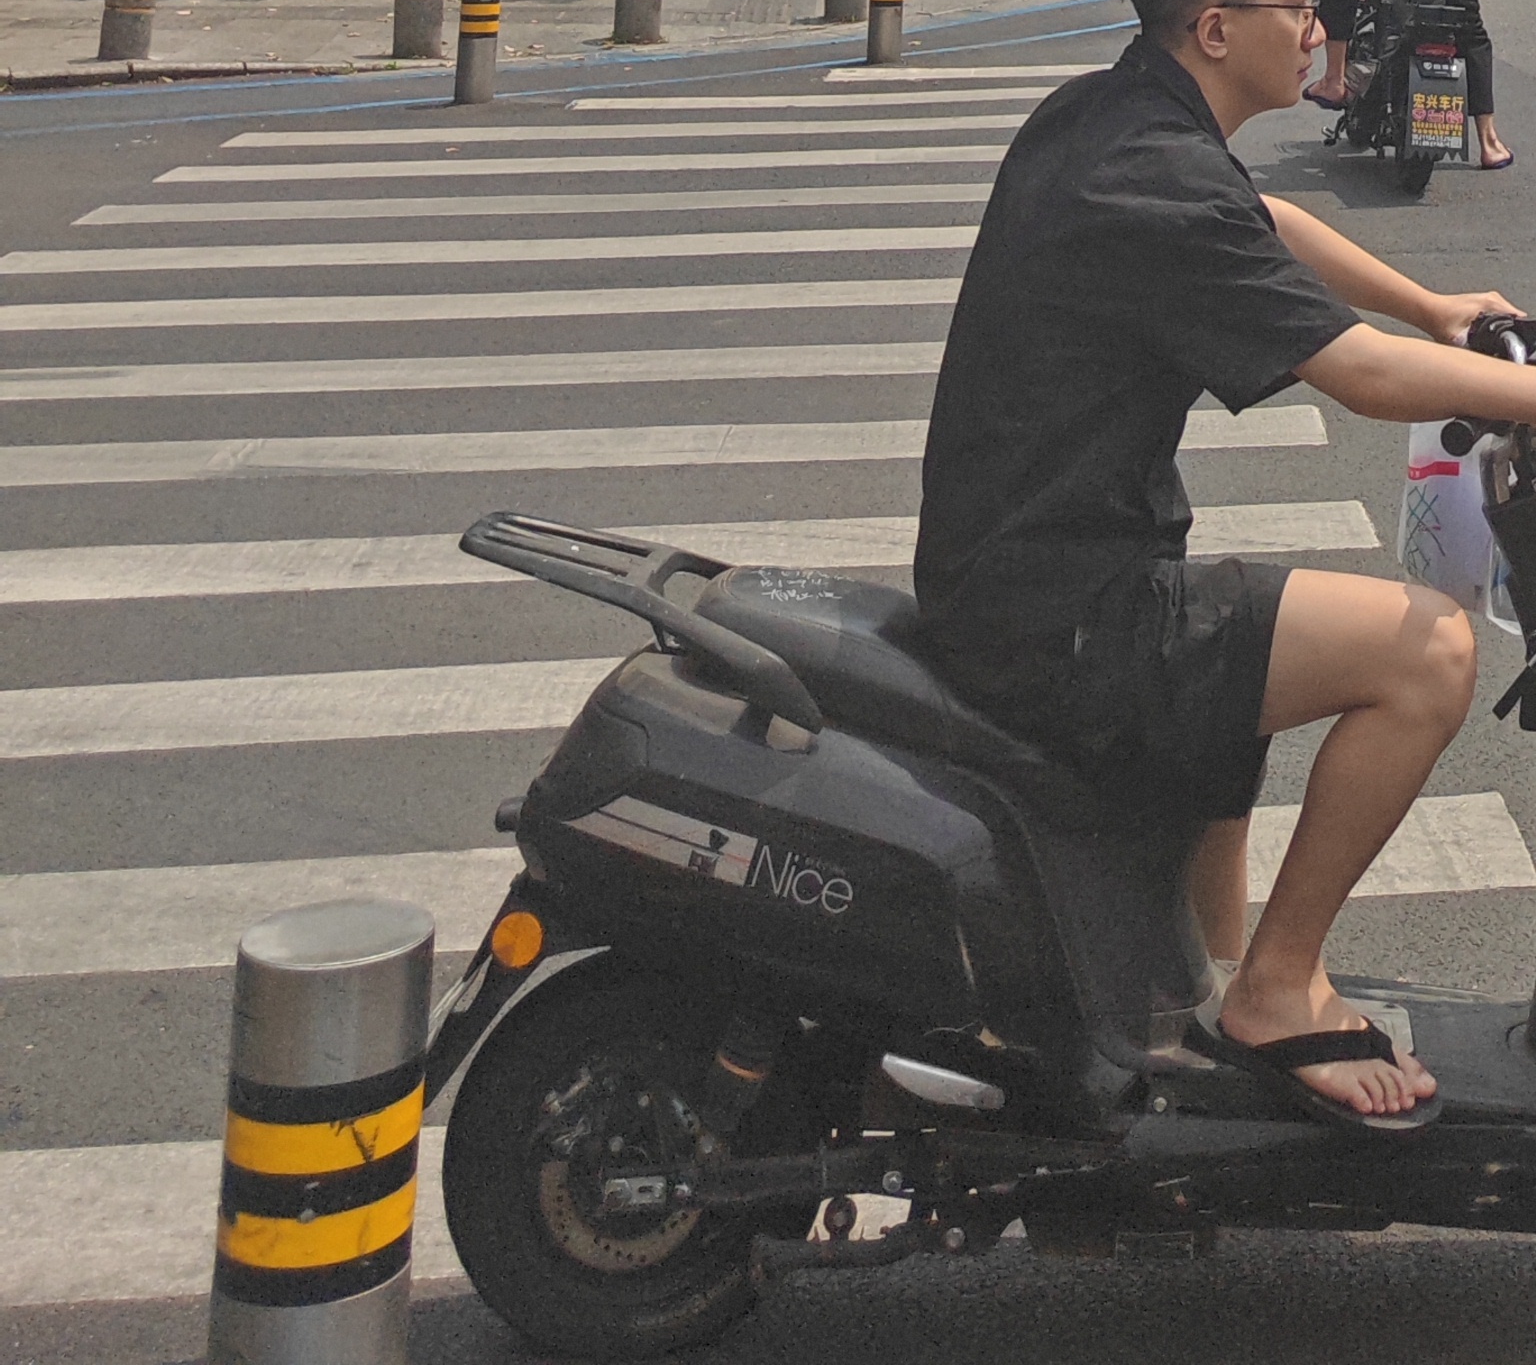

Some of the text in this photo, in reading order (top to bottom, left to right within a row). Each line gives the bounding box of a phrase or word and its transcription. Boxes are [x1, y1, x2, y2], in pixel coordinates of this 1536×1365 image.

[1412, 93, 1465, 112] 宏兴车行
[750, 844, 854, 914] Nice
